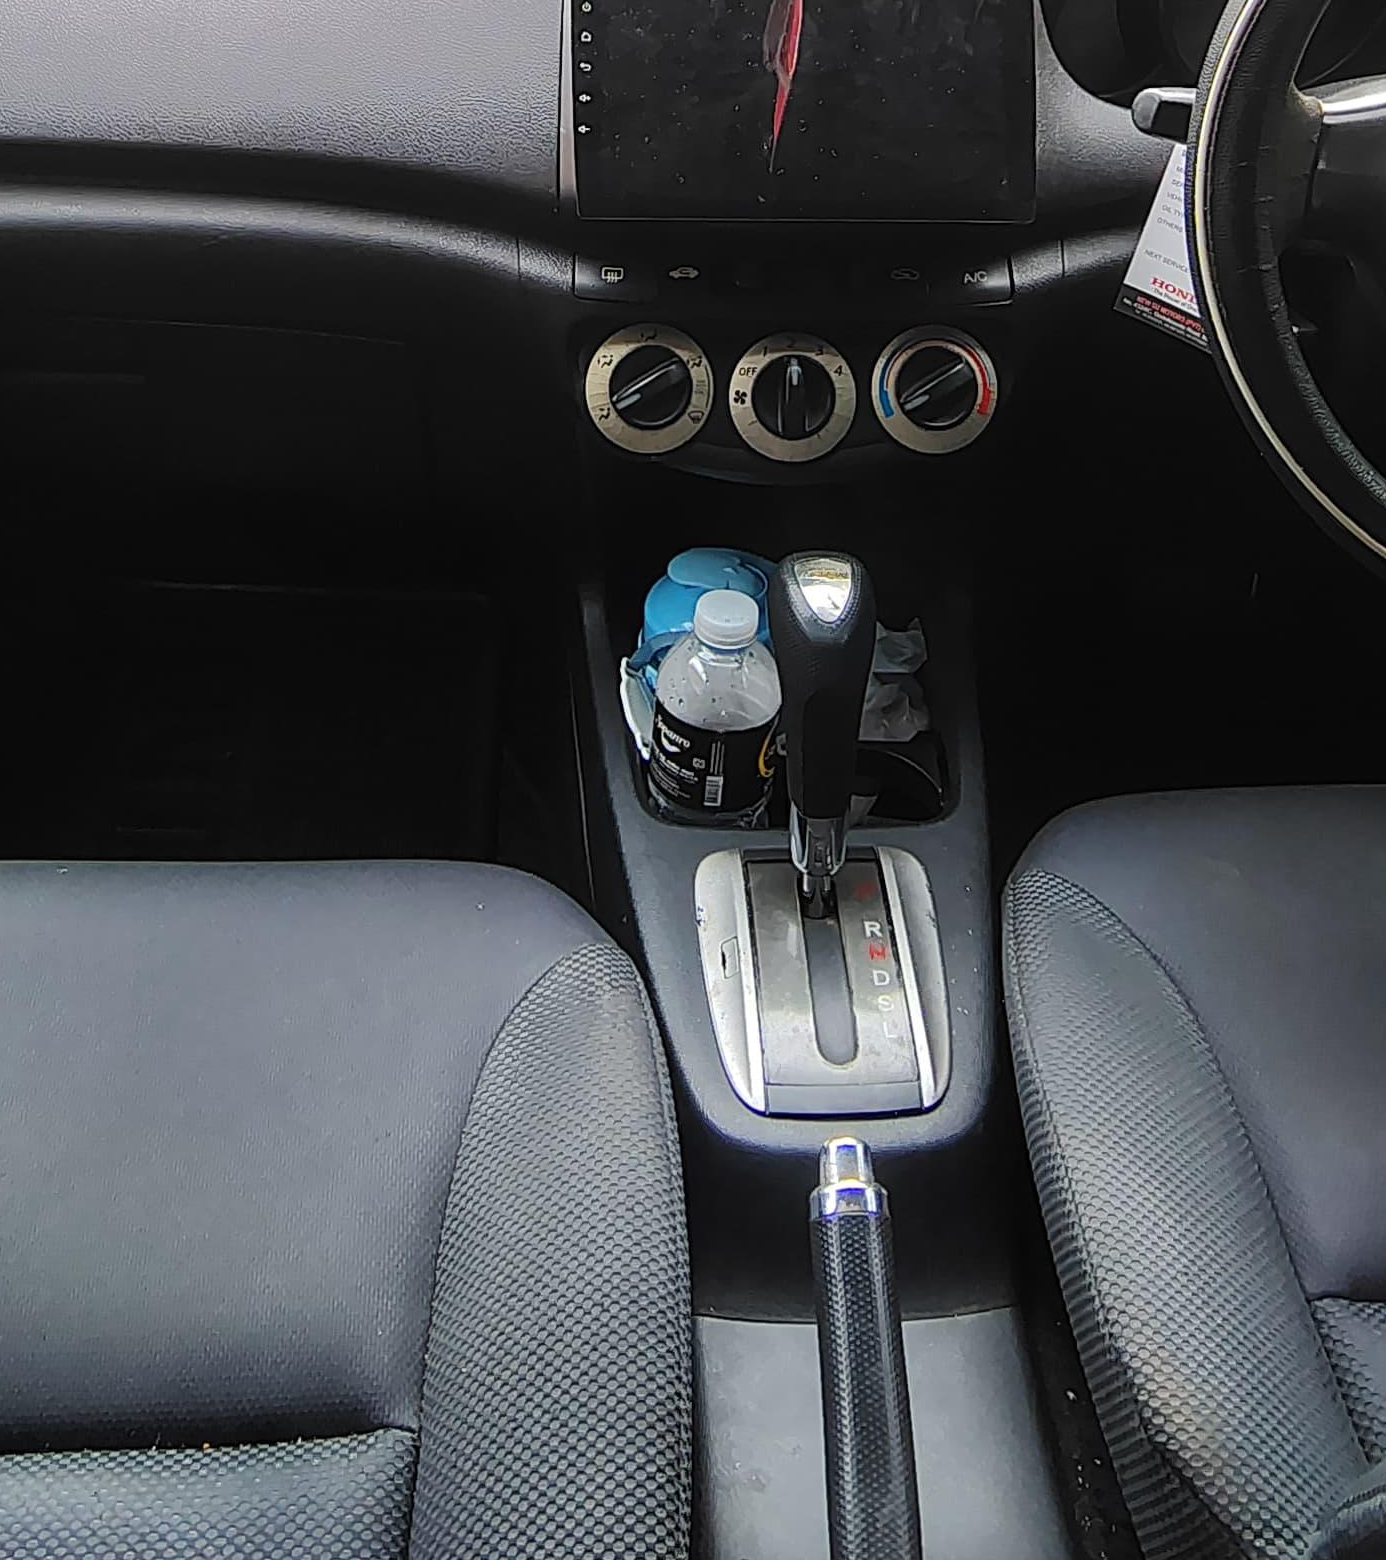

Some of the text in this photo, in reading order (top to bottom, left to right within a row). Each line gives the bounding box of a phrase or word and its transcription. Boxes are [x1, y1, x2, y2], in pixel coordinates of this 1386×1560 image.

[963, 270, 988, 284] A/C
[738, 366, 758, 377] OFF
[833, 365, 843, 377] 4
[863, 920, 883, 938] R
[872, 969, 891, 987] D
[877, 994, 895, 1012] S
[882, 1021, 898, 1040] L
